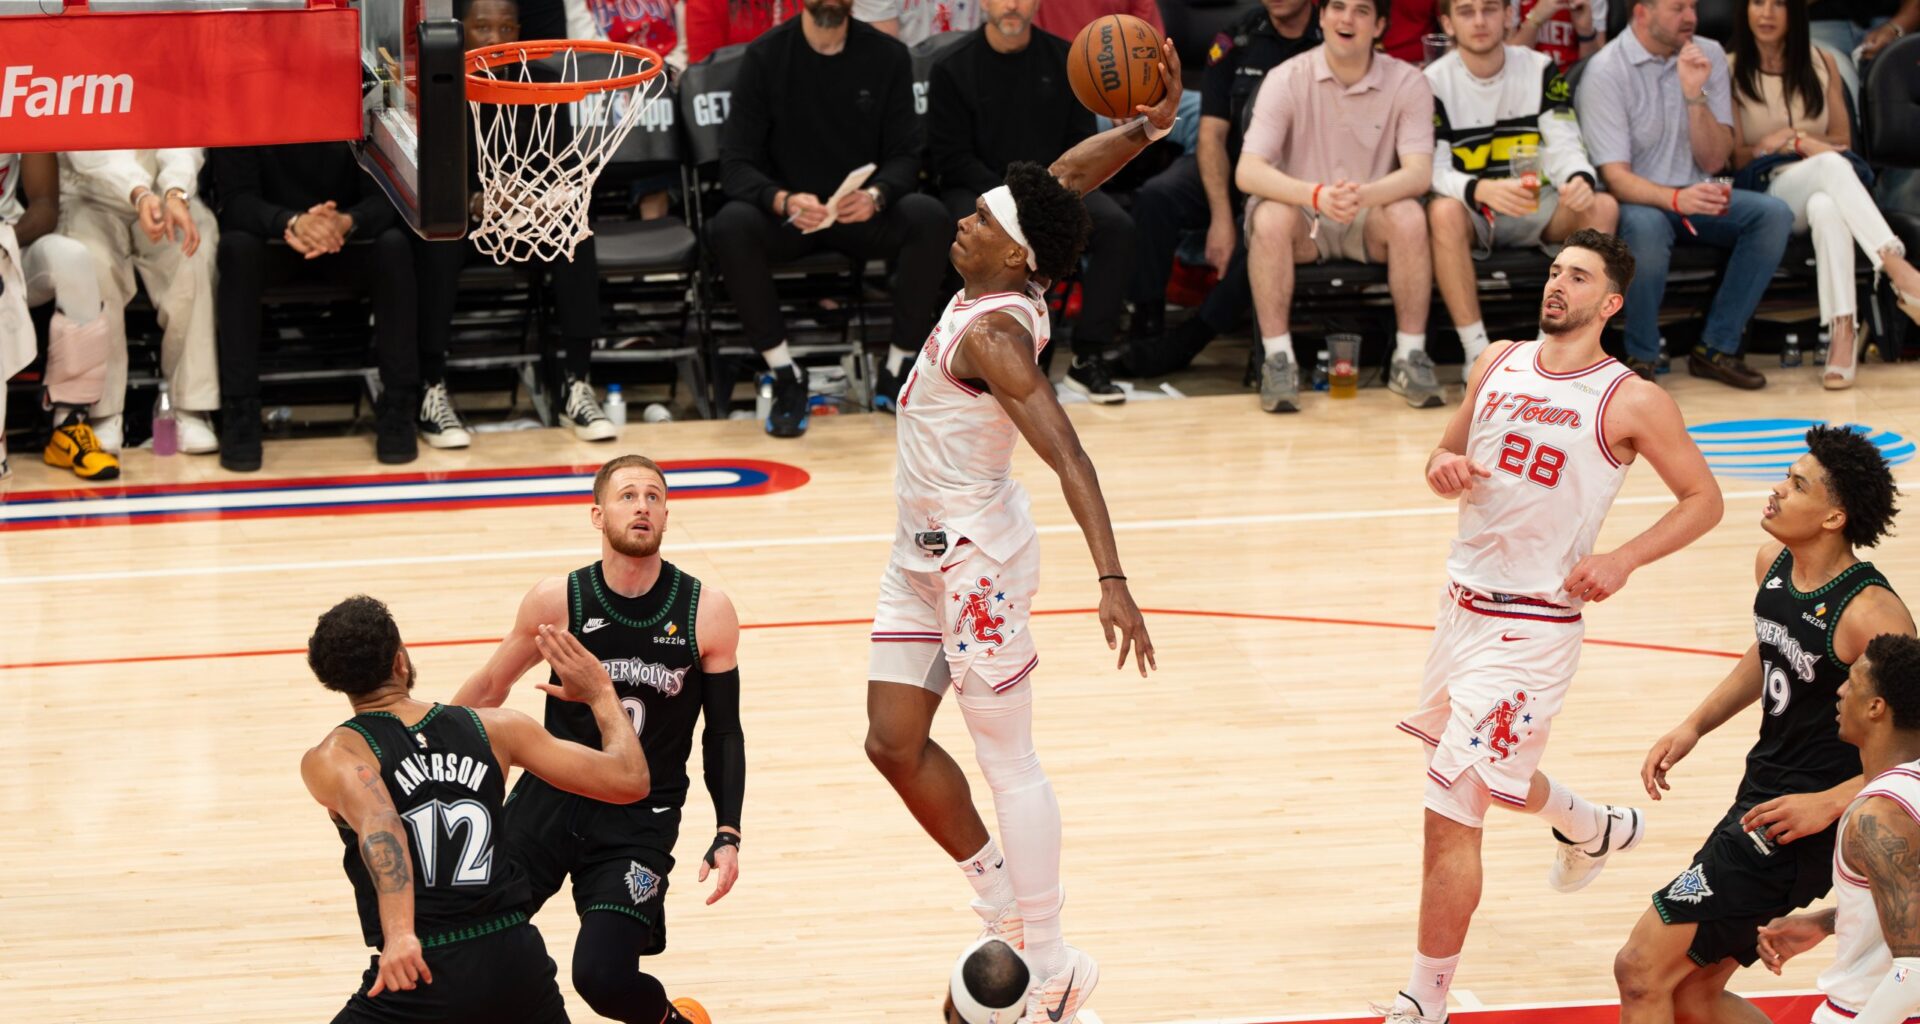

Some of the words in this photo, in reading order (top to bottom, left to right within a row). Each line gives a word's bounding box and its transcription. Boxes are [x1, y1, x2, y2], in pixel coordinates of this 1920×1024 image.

[1097, 24, 1121, 92] Wilson
[0, 65, 134, 118] Farm
[693, 91, 732, 126] GET
[1477, 391, 1582, 429] H-Town
[1495, 431, 1568, 490] 28
[653, 635, 686, 646] sezzle
[1801, 611, 1828, 630] sezzle
[1761, 659, 1791, 717] 19
[400, 798, 494, 888] 12
